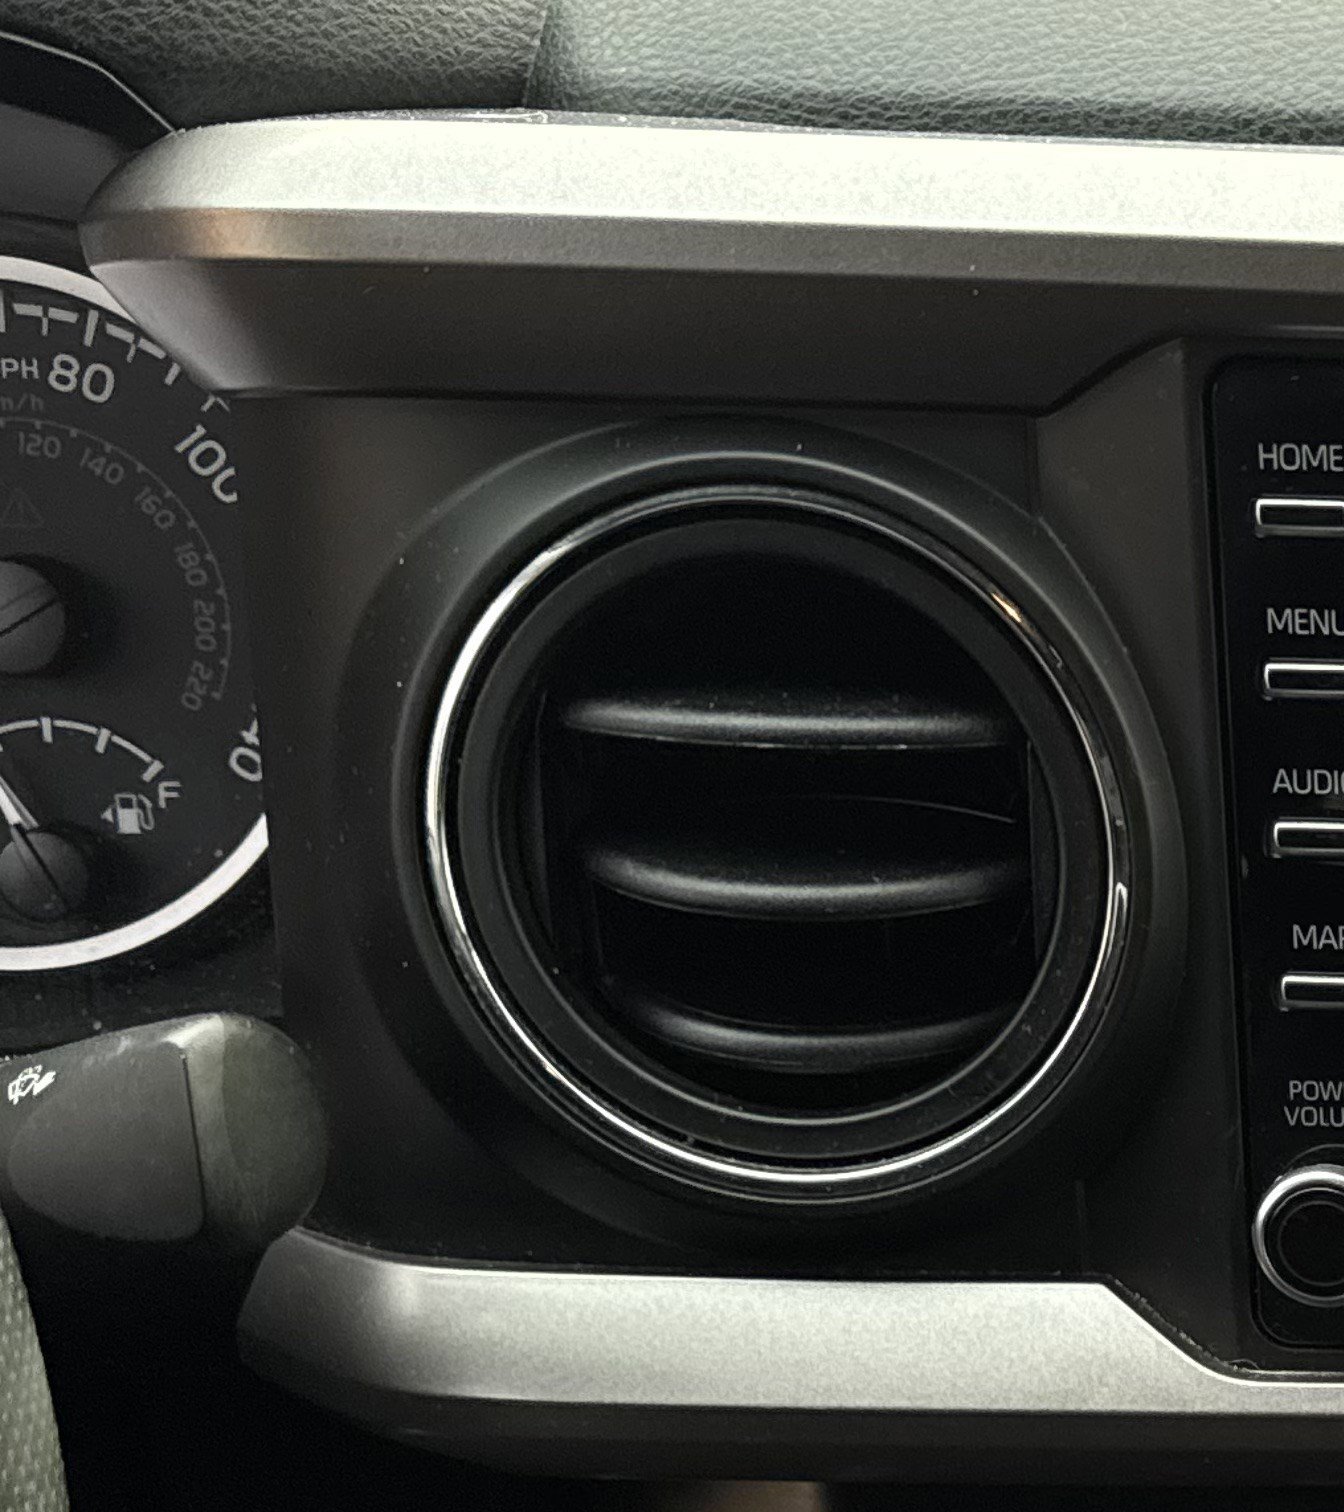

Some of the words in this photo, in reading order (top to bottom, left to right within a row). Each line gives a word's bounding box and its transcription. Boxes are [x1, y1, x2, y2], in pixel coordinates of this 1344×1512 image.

[47, 352, 116, 405] 80
[18, 430, 62, 459] 120
[1258, 442, 1344, 472] HOME
[80, 446, 126, 486] 140
[134, 485, 177, 531] 160
[173, 541, 208, 588] 180
[157, 780, 181, 808] F
